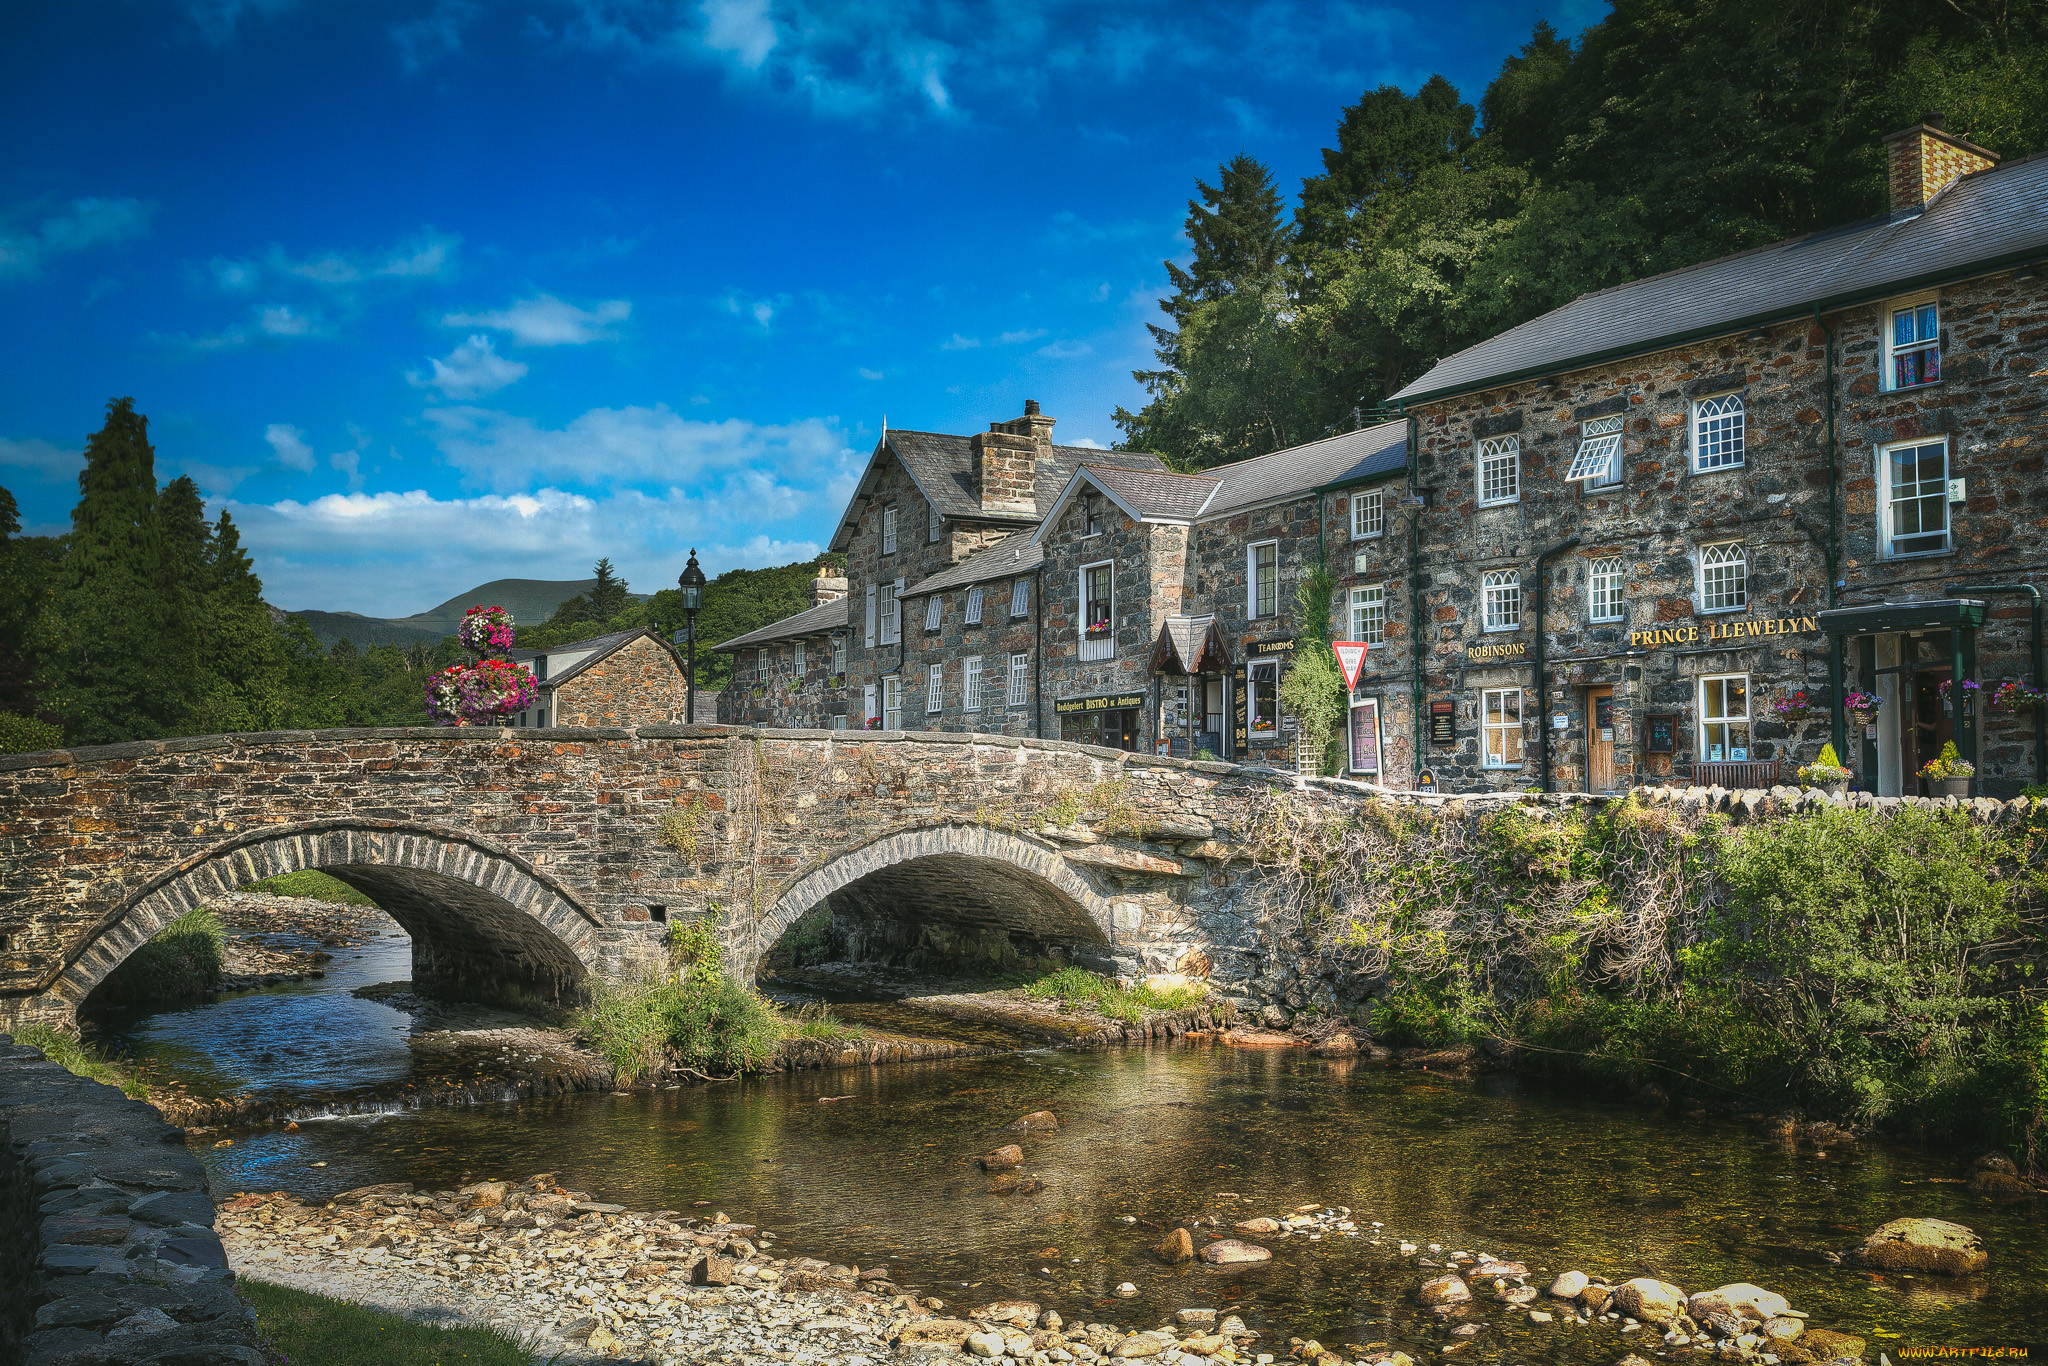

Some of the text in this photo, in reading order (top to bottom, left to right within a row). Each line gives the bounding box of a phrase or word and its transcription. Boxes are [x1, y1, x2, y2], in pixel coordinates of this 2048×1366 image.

[1631, 616, 1816, 646] PRINCE LLEWELYN
[1258, 640, 1294, 653] TEAROOMS
[1468, 643, 1525, 659] ROBINSONS
[1057, 702, 1083, 712] Beddgelert
[1086, 697, 1108, 710] BISTRO
[1117, 696, 1141, 706] Antiques
